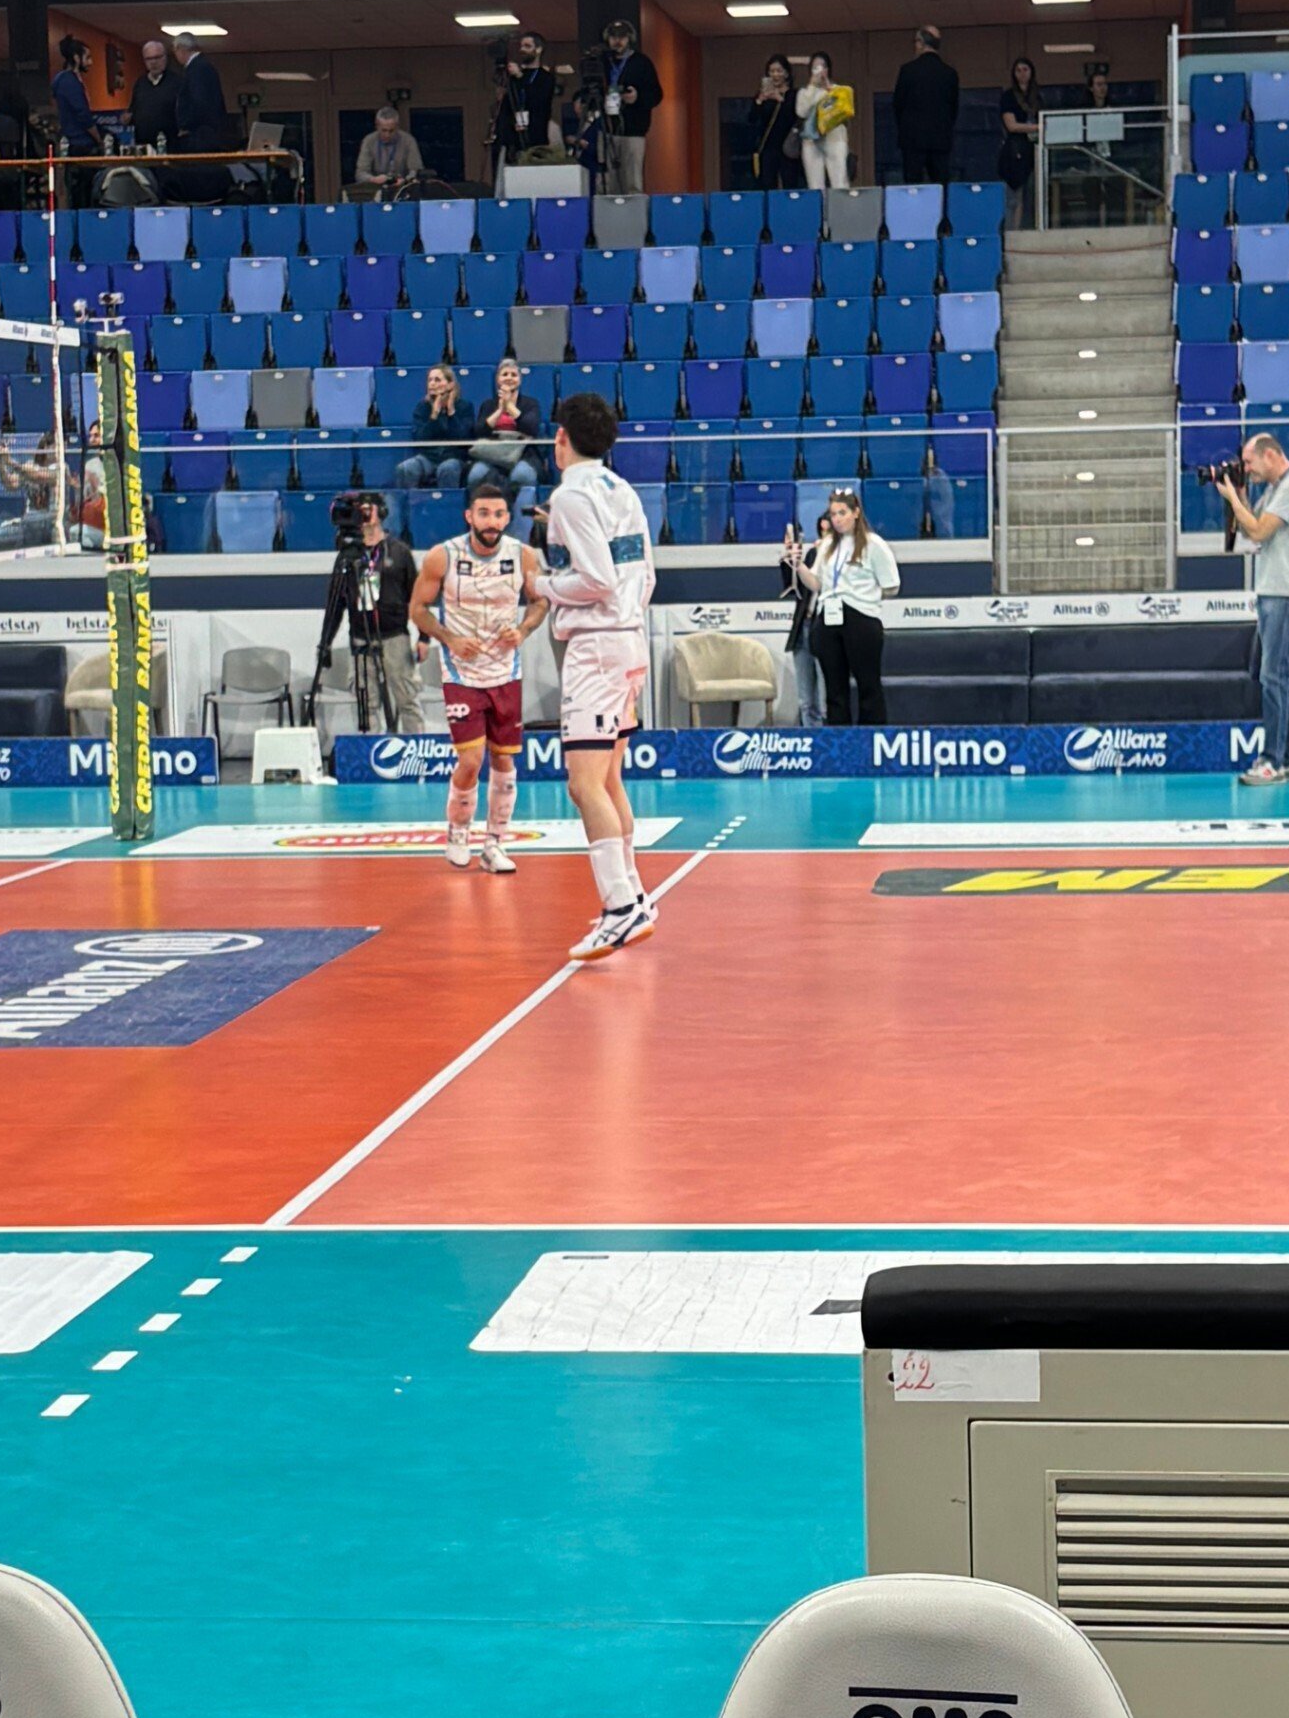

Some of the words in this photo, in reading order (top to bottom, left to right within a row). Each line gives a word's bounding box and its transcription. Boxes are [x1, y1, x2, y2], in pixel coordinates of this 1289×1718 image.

[755, 608, 793, 622] Allianz
[902, 605, 942, 619] Allianz
[1053, 601, 1095, 615] Allianz
[1206, 599, 1247, 613] Allianz
[66, 615, 109, 630] belsta
[135, 591, 152, 690] BANCA
[404, 737, 458, 758] Allian
[745, 732, 812, 753] Allianz
[873, 730, 1006, 768] Milano
[1098, 729, 1167, 750] Allianz
[69, 743, 198, 777] Mino
[135, 700, 153, 815] CREDEM
